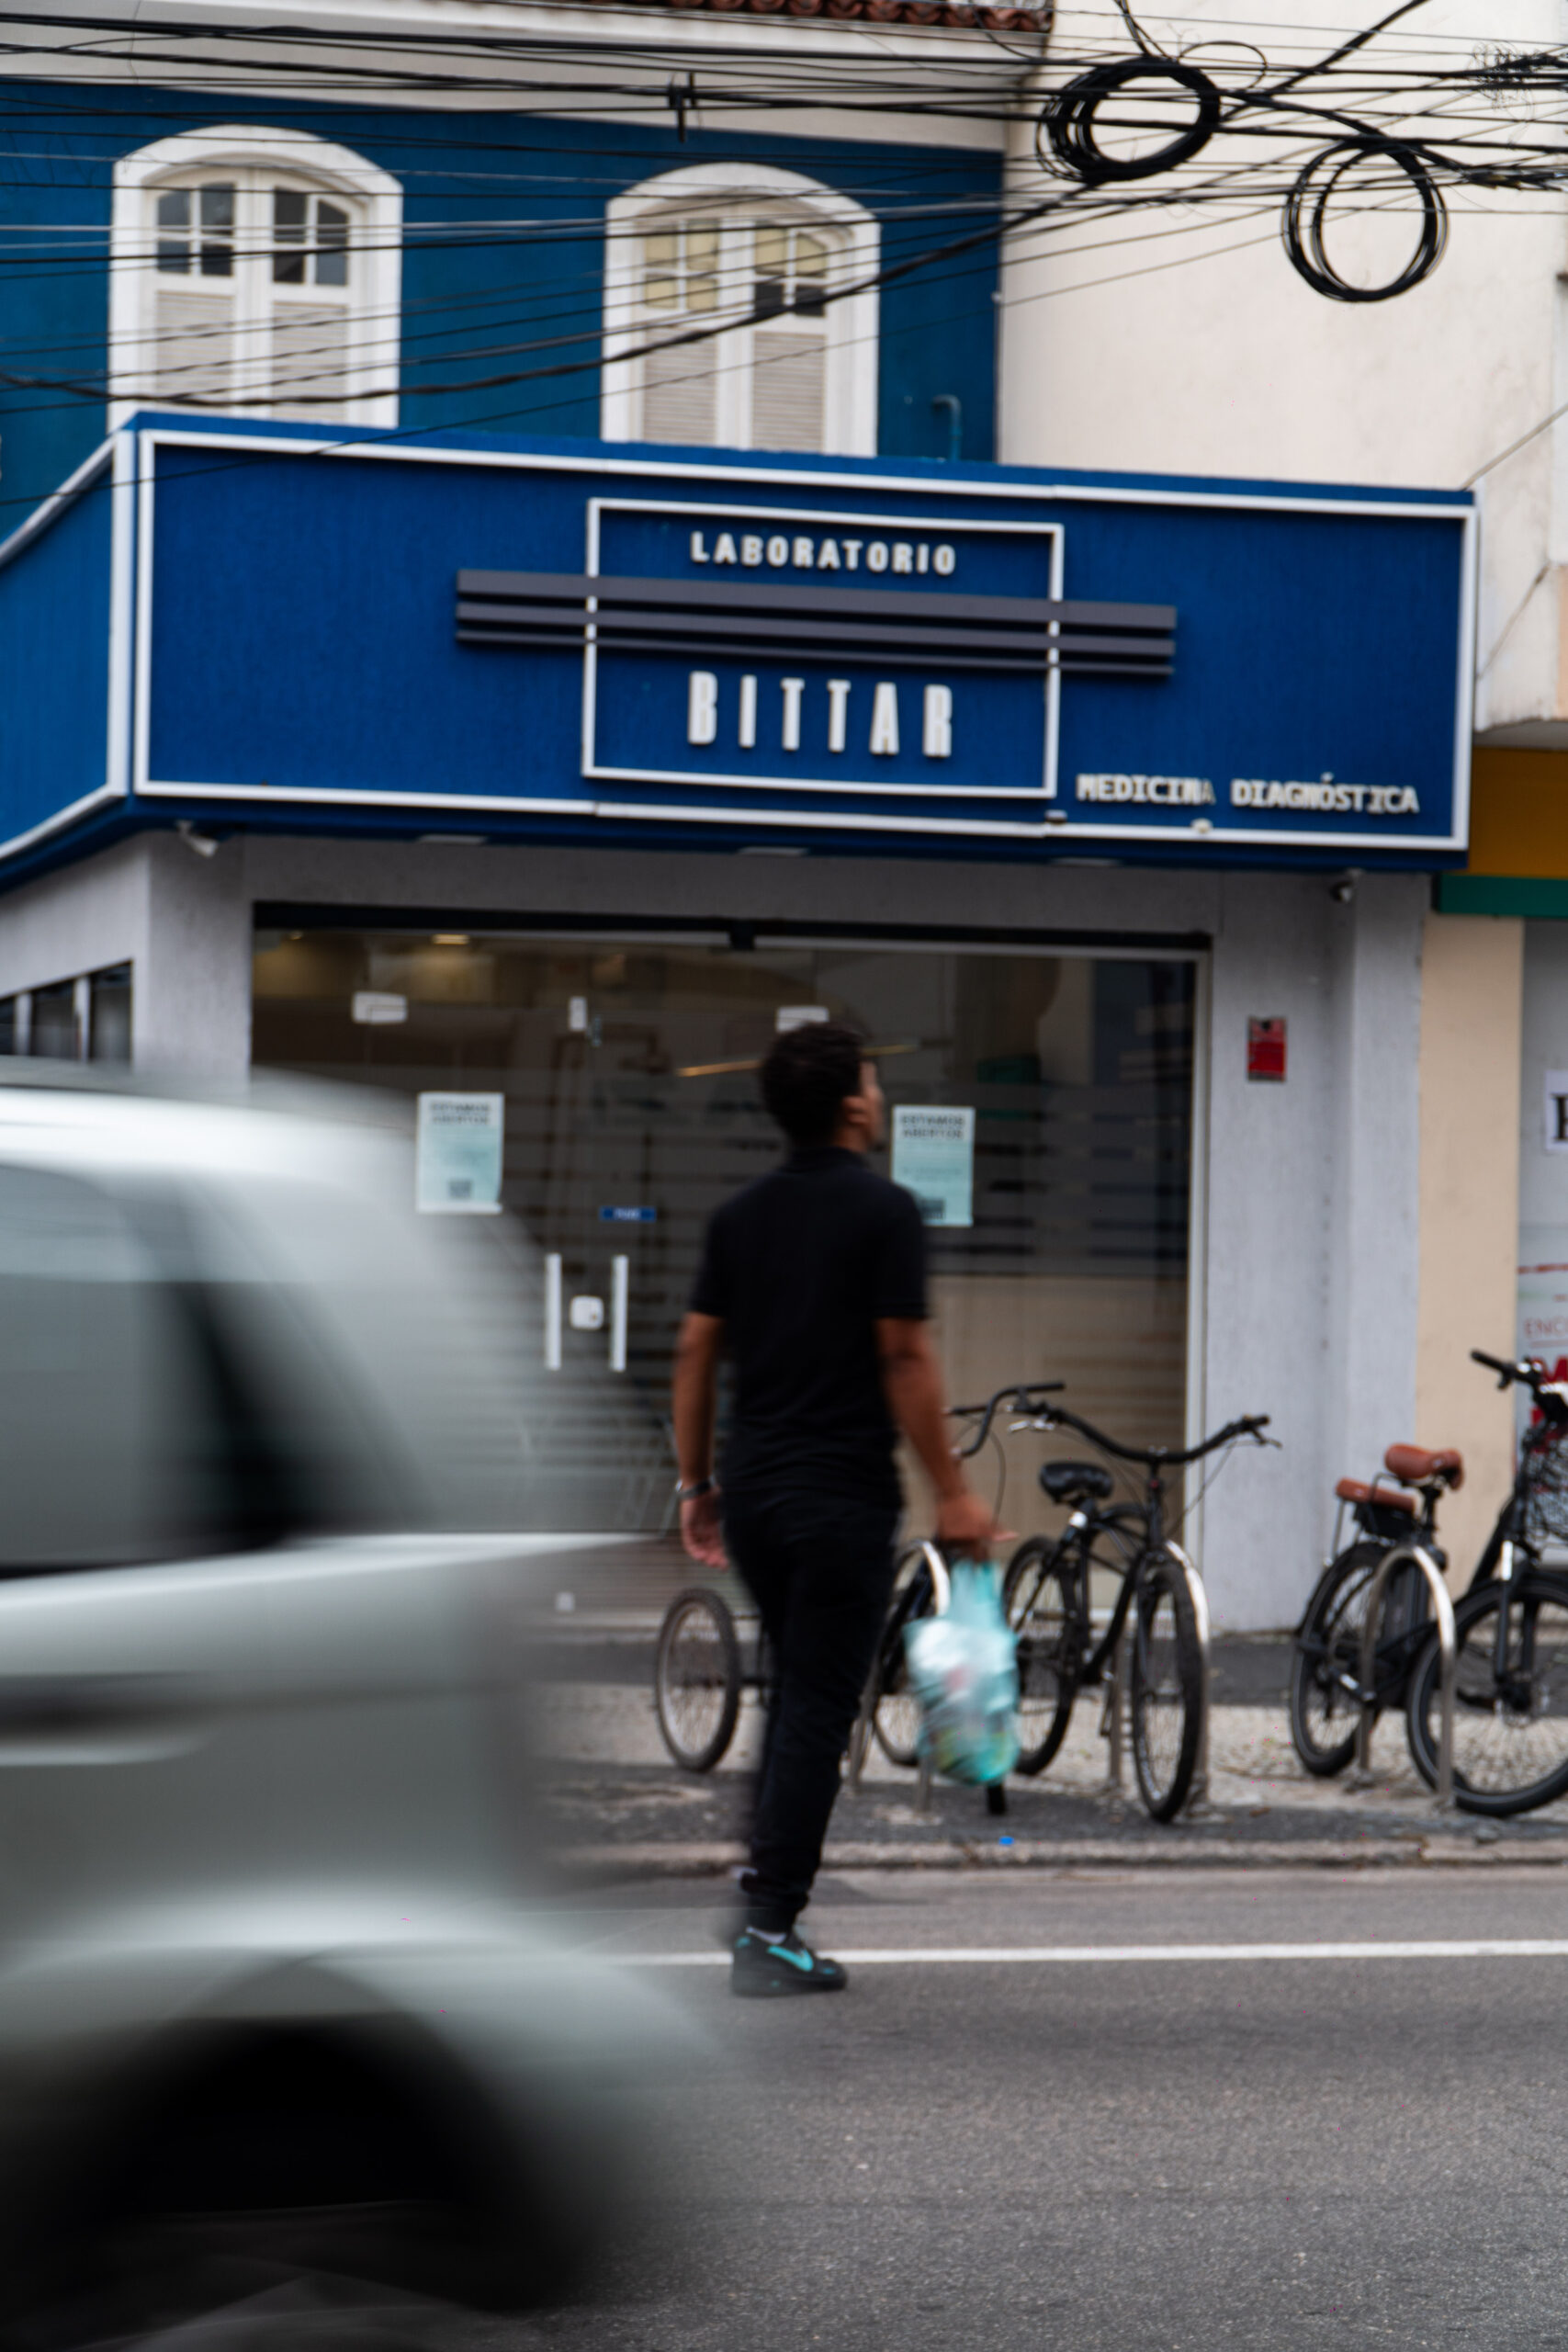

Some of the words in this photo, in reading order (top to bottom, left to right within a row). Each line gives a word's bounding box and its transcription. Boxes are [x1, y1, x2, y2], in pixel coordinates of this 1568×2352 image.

[690, 530, 957, 576] LABORATORIO
[687, 670, 953, 758] BITTAR
[1076, 773, 1216, 805] MEDICINA
[1230, 772, 1420, 814] DIAGNÓSTICA
